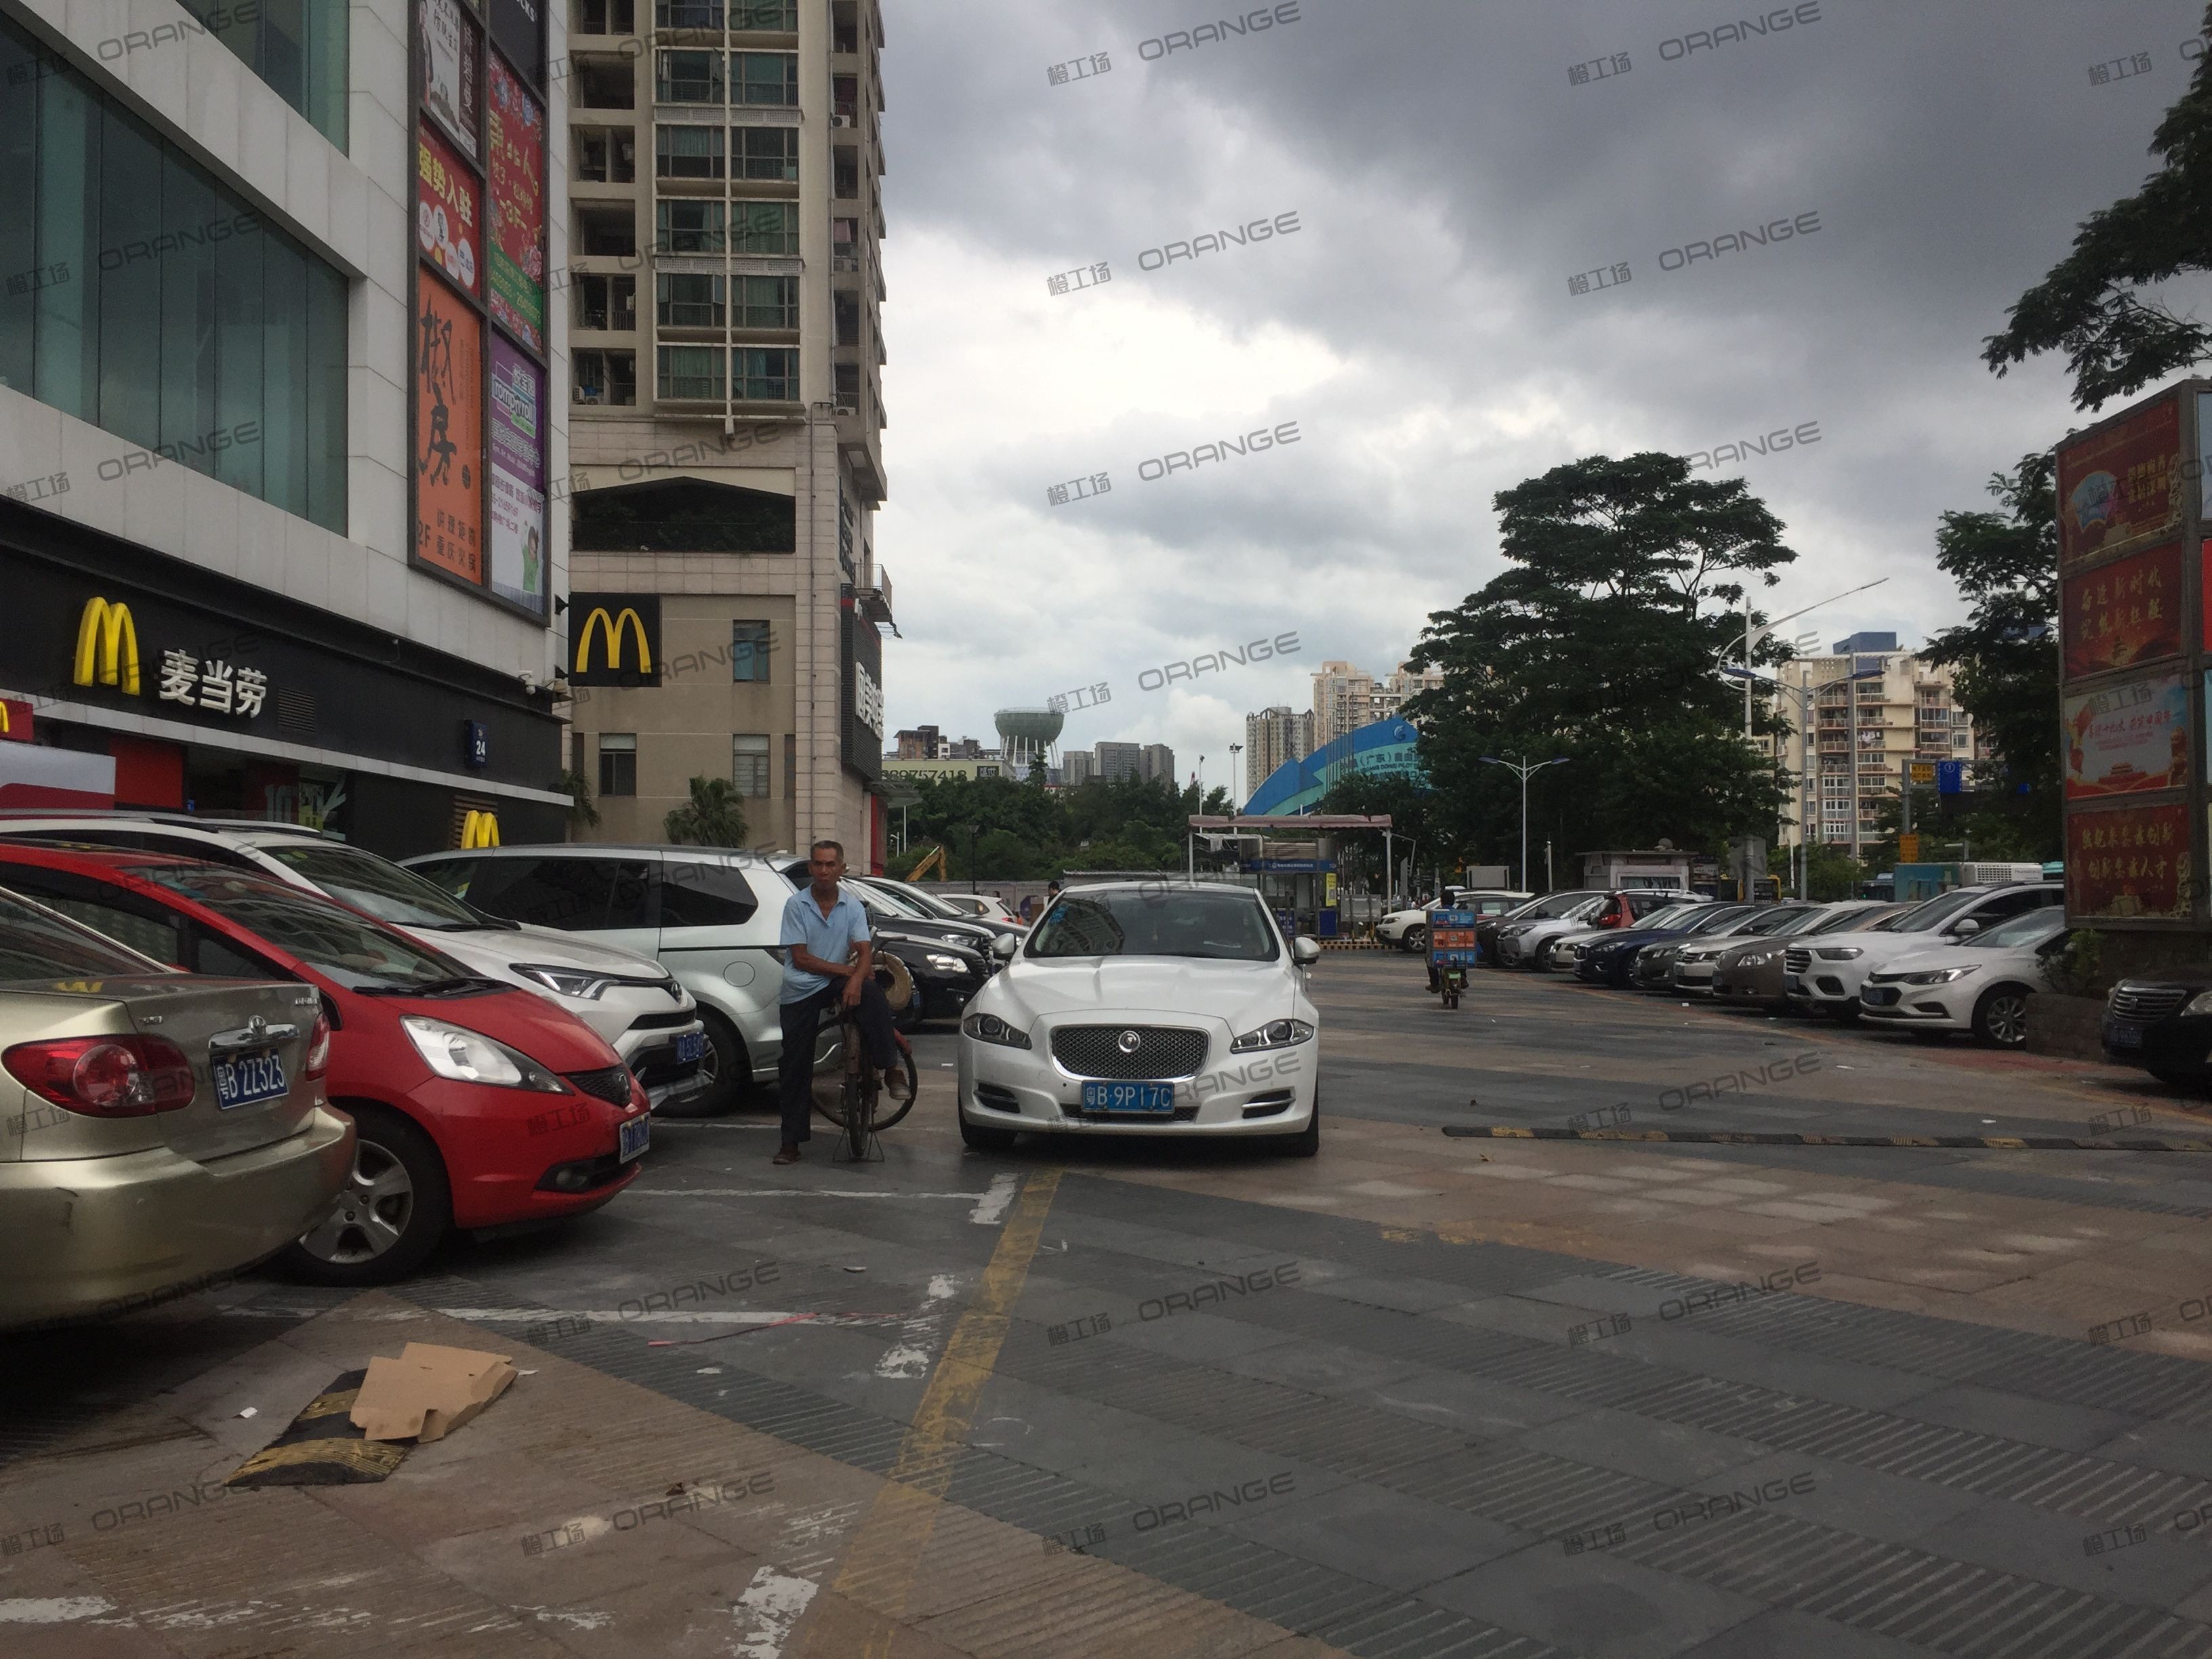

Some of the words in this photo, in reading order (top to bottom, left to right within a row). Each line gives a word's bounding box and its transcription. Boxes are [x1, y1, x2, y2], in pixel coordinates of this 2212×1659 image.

[419, 142, 472, 227] 强势入驻
[159, 649, 268, 718] 麦当劳
[476, 739, 486, 757] 24
[2088, 854, 2167, 880] 创新要靠人才
